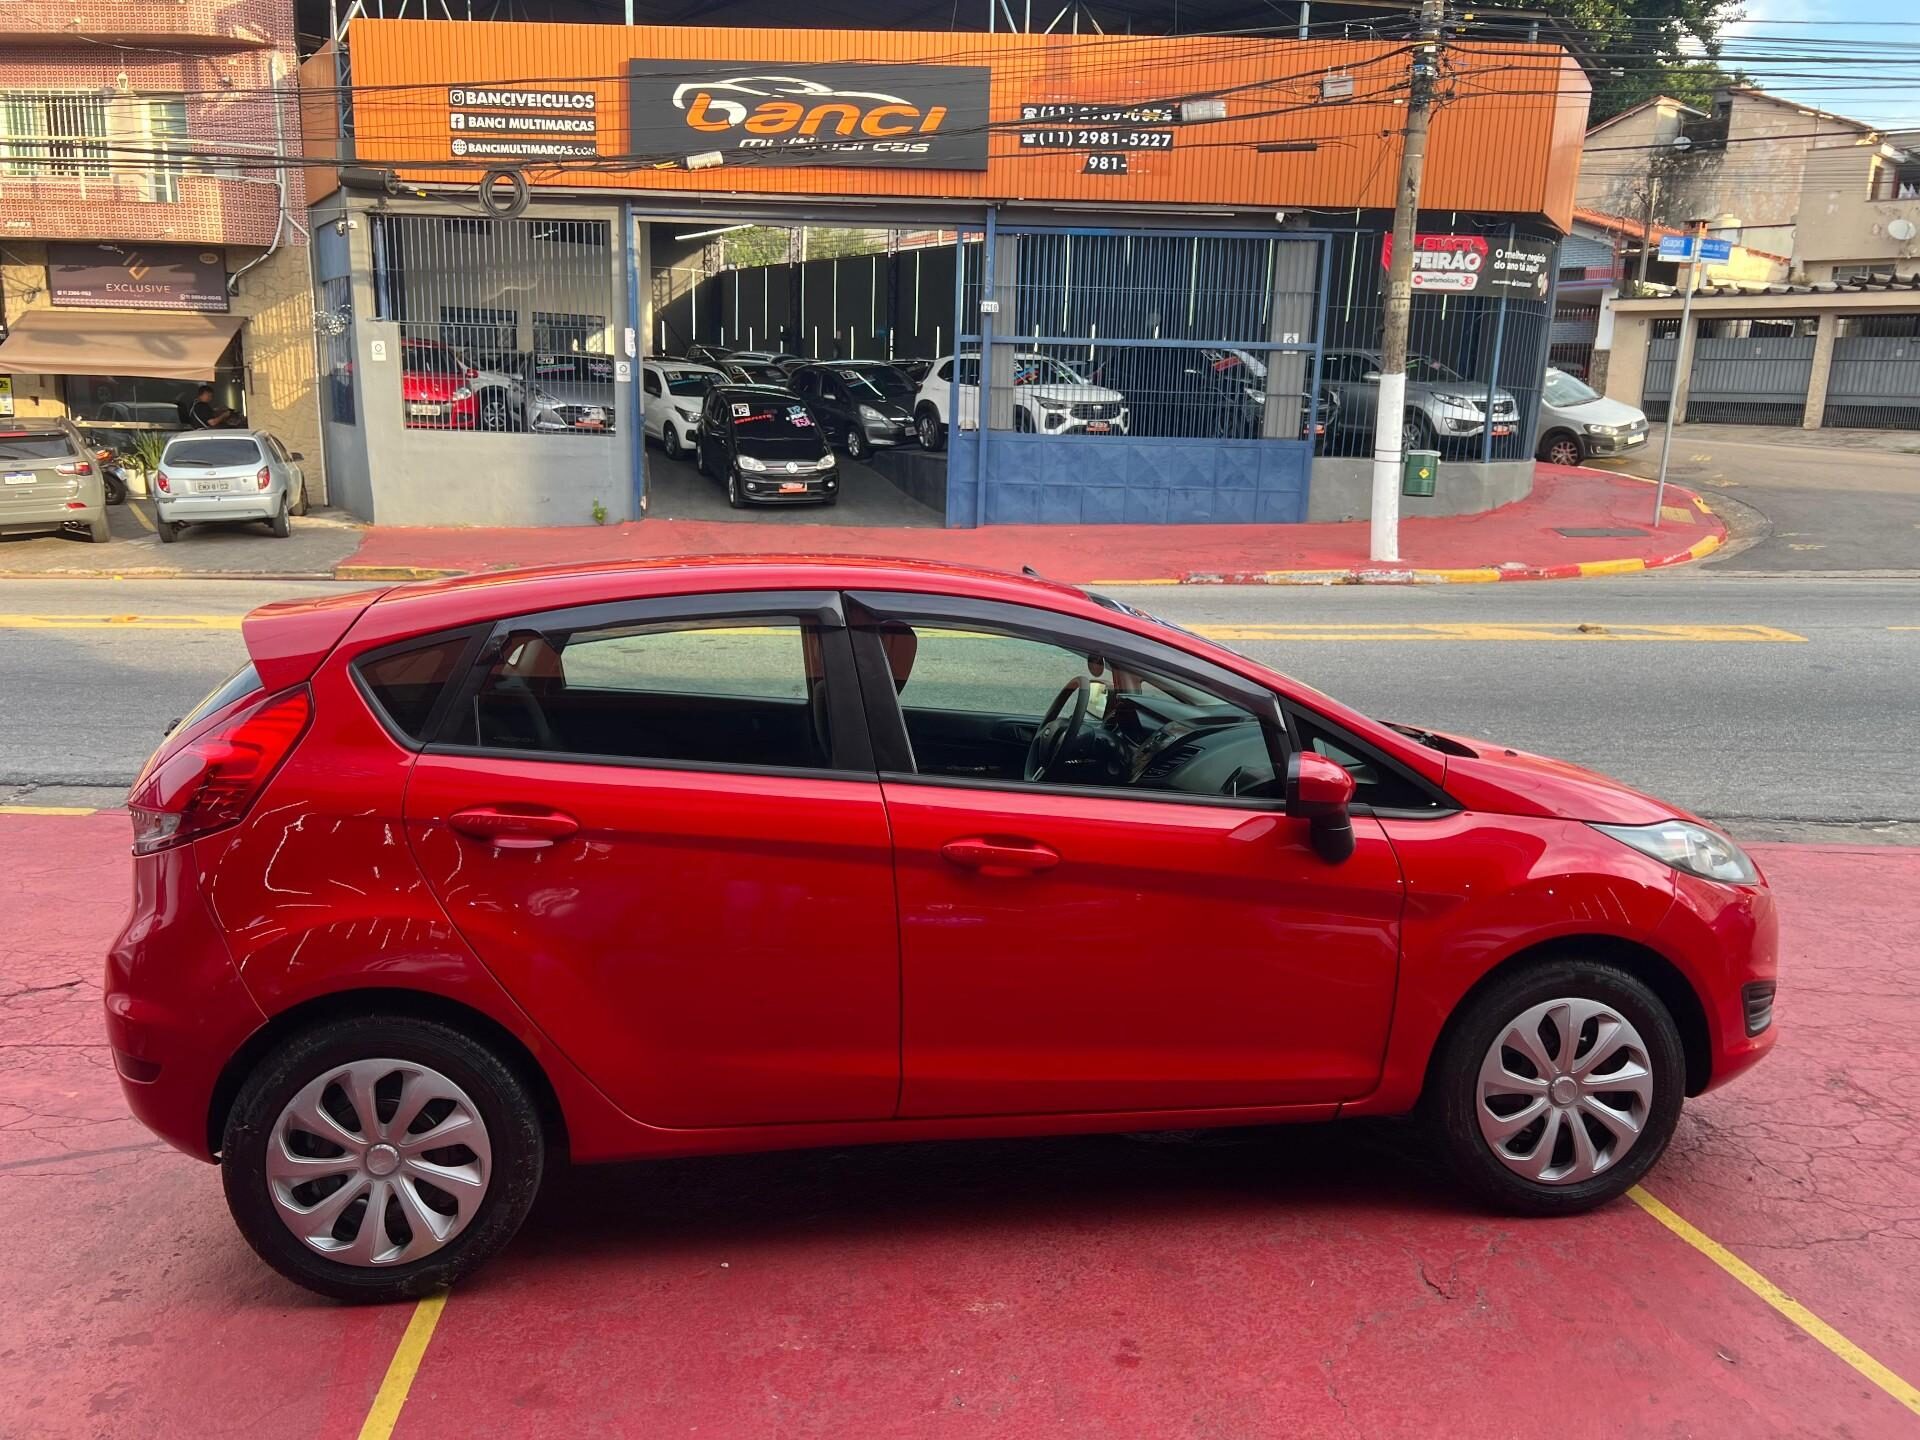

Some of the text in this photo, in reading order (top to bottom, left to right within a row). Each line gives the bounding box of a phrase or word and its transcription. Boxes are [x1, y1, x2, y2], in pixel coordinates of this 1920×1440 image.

[466, 91, 595, 109] BANCIVEICULOS
[468, 116, 595, 132] BANCI MULTIMARCAS
[1039, 131, 1172, 147] (11) 2981-5227
[1088, 157, 1128, 170] 981-
[1426, 240, 1470, 252] BLACK
[1412, 250, 1481, 271] FEIRÃO
[1495, 248, 1504, 259] O
[1504, 250, 1527, 261] melhor
[1493, 260, 1506, 270] do
[1506, 262, 1519, 271] ano
[1423, 276, 1460, 284] webmotors
[105, 283, 171, 294] EXCLUSIVE
